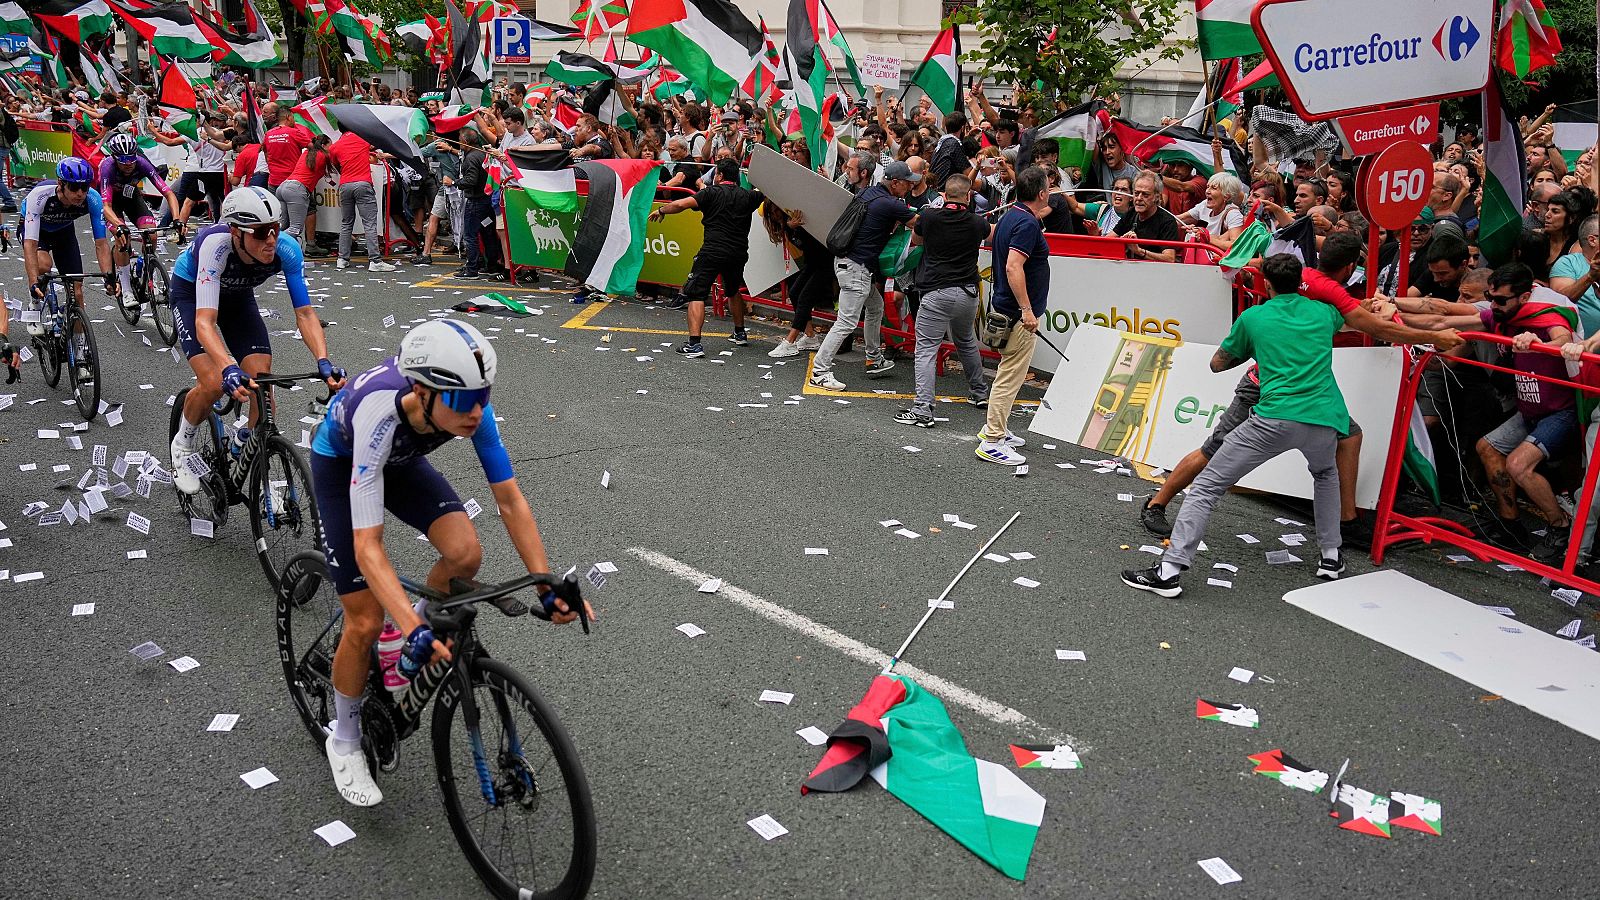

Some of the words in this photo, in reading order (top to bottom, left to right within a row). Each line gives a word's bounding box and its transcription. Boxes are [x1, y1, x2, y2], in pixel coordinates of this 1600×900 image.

[502, 21, 523, 54] P
[1294, 33, 1422, 73] Carrefour
[1354, 124, 1405, 142] Carrefour
[1378, 168, 1425, 204] 150
[1045, 306, 1182, 342] novables
[278, 584, 290, 662] BLACK
[340, 787, 372, 805] nimbl
